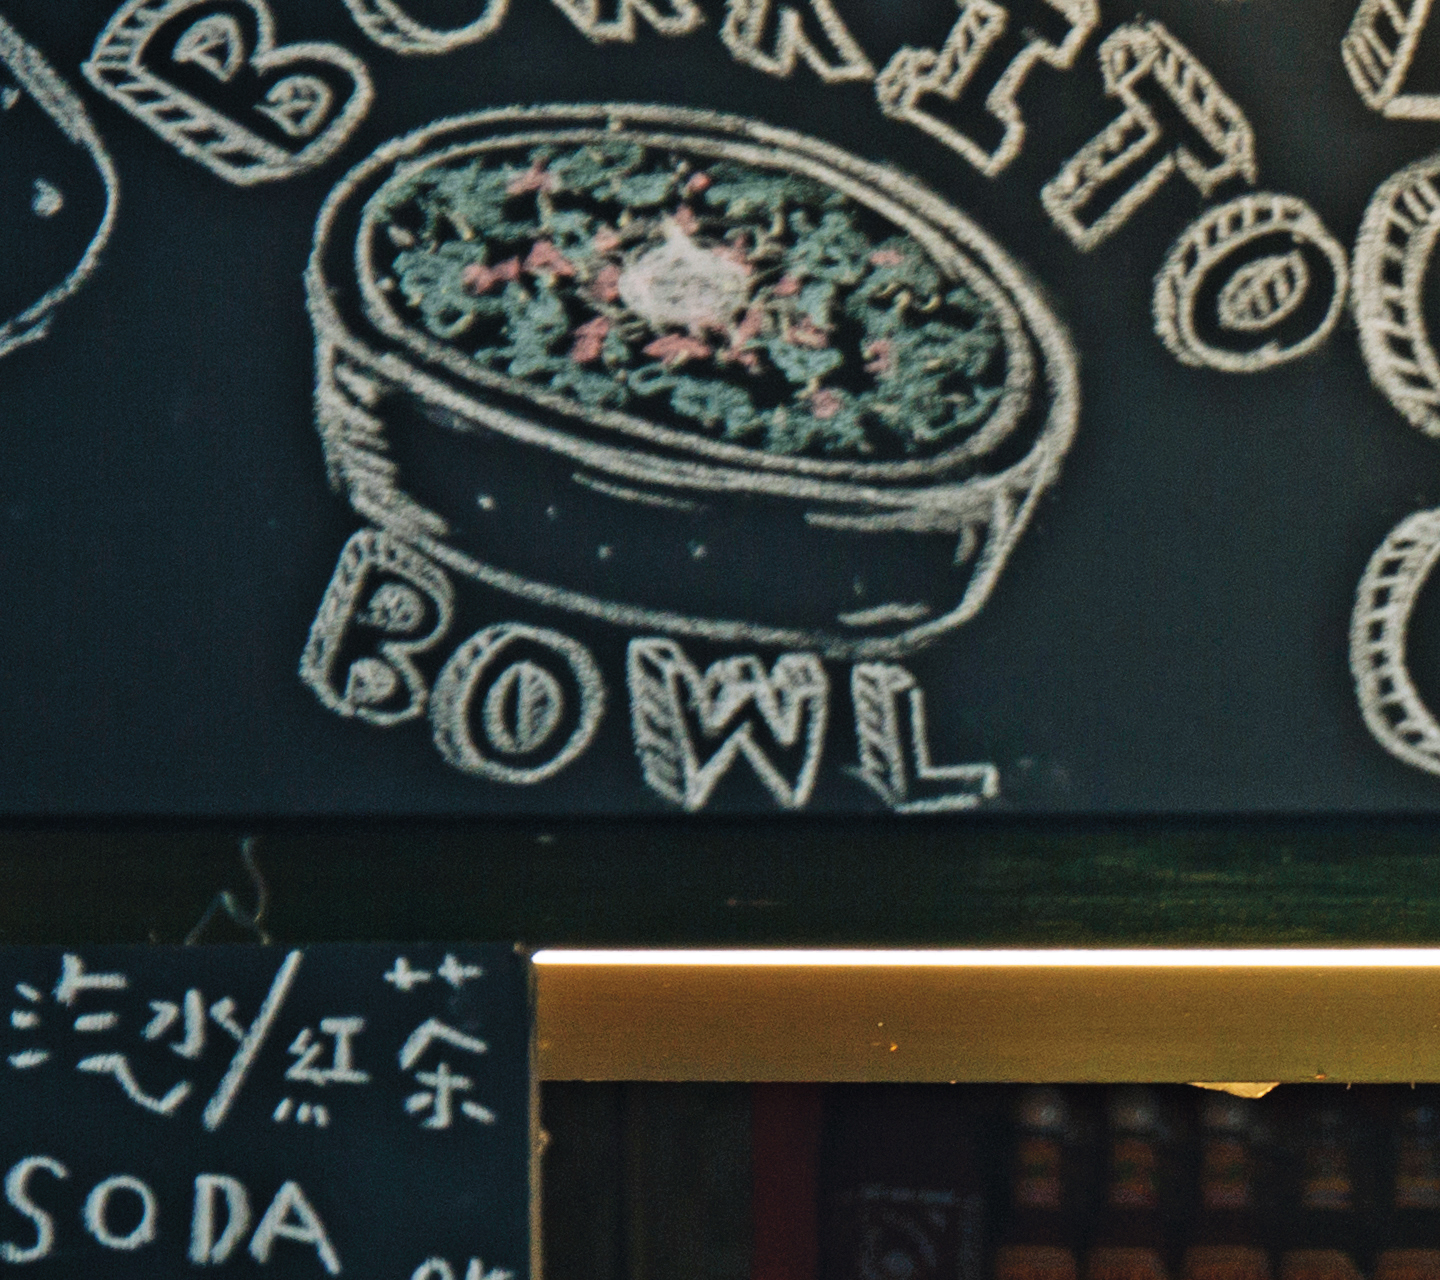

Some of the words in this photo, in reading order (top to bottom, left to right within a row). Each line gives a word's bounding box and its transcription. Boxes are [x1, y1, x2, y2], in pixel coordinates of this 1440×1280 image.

[82, 0, 1348, 371] BITO
[300, 528, 998, 812] BOWL
[0, 1155, 342, 1275] SODA
